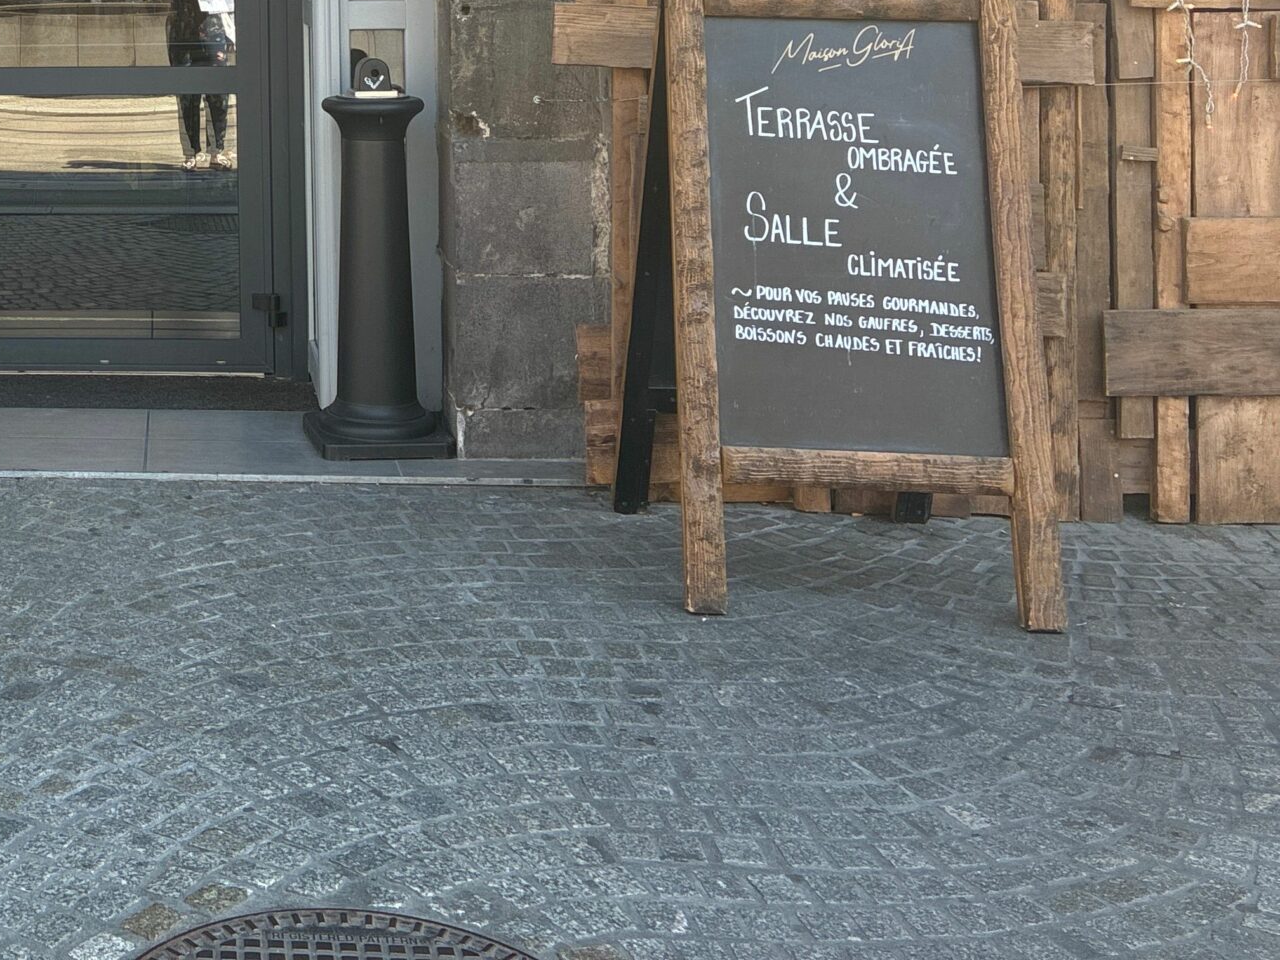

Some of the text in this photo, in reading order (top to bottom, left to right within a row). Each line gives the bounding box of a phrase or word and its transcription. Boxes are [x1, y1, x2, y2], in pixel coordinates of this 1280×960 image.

[771, 33, 849, 74] Maison
[734, 86, 880, 144] TERRASSE
[847, 144, 959, 176] OMBRAGÉE
[833, 172, 859, 209] &
[743, 190, 843, 248] SALLE
[756, 285, 980, 320] POUR VOS PAUSES GOURMANDES,
[733, 301, 817, 325] DÉCOUVREZ
[824, 313, 853, 328] NOS
[929, 322, 996, 344] DESSERTS,
[734, 324, 808, 345] BOISSONS
[815, 333, 881, 353] CHAUDES
[885, 338, 903, 356] ET
